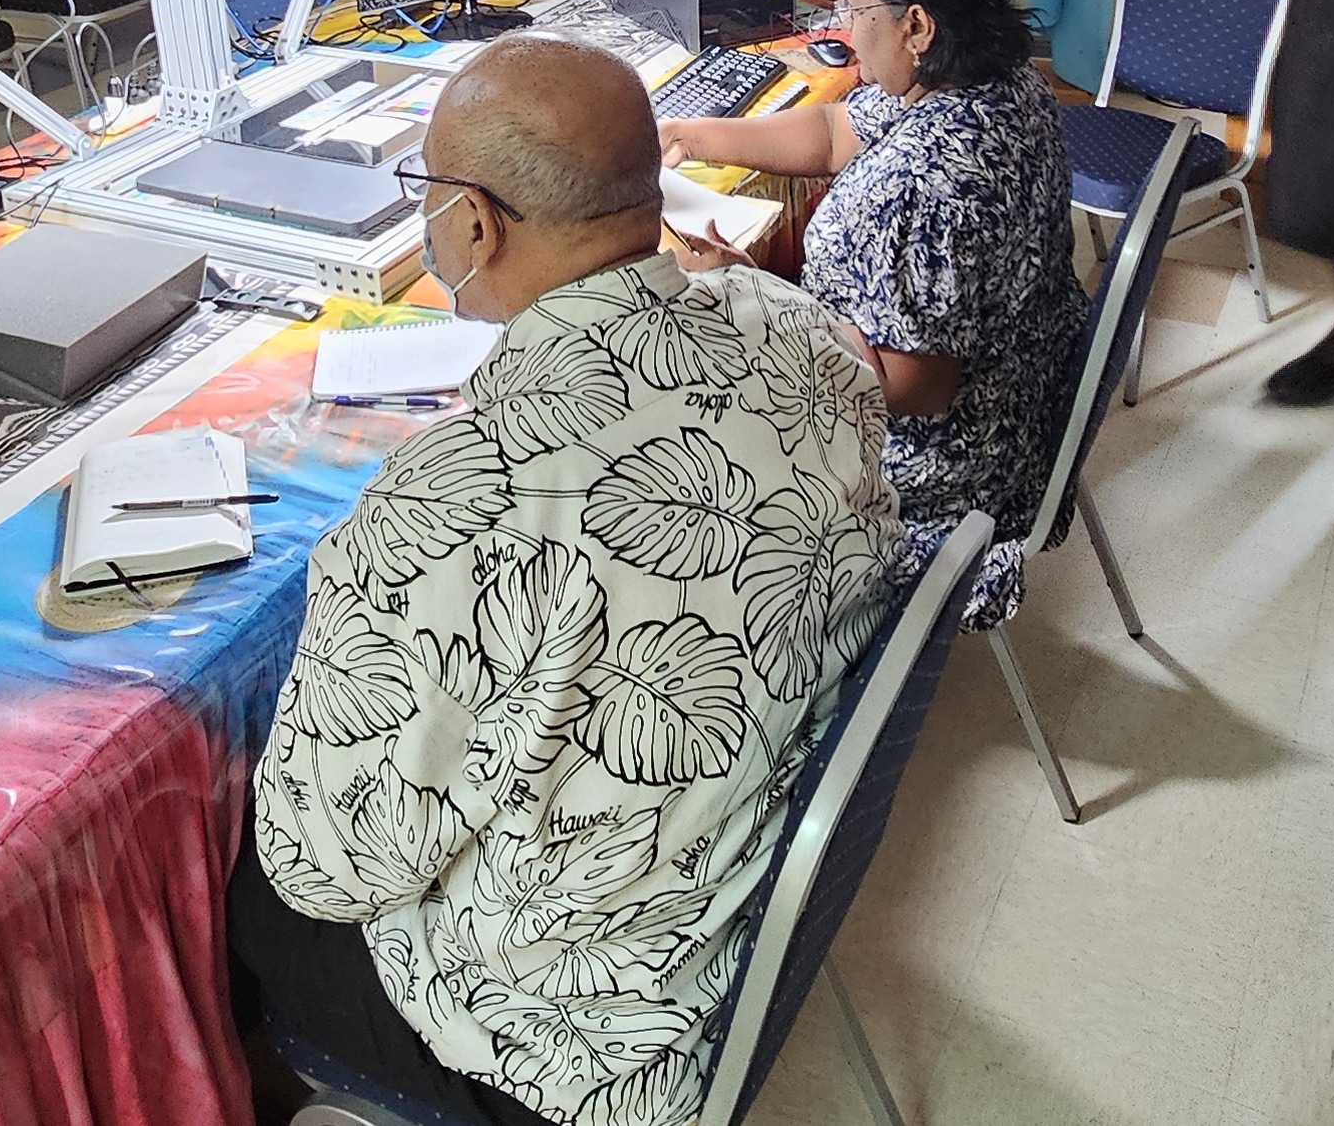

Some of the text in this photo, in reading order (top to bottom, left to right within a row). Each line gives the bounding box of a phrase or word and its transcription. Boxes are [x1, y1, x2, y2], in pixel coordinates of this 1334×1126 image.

[684, 392, 732, 423] aloha
[471, 536, 516, 586] aloha
[280, 769, 311, 813] aloha
[328, 764, 376, 818] Hawaii
[550, 804, 624, 838] Hawaii
[671, 834, 712, 881] aloha
